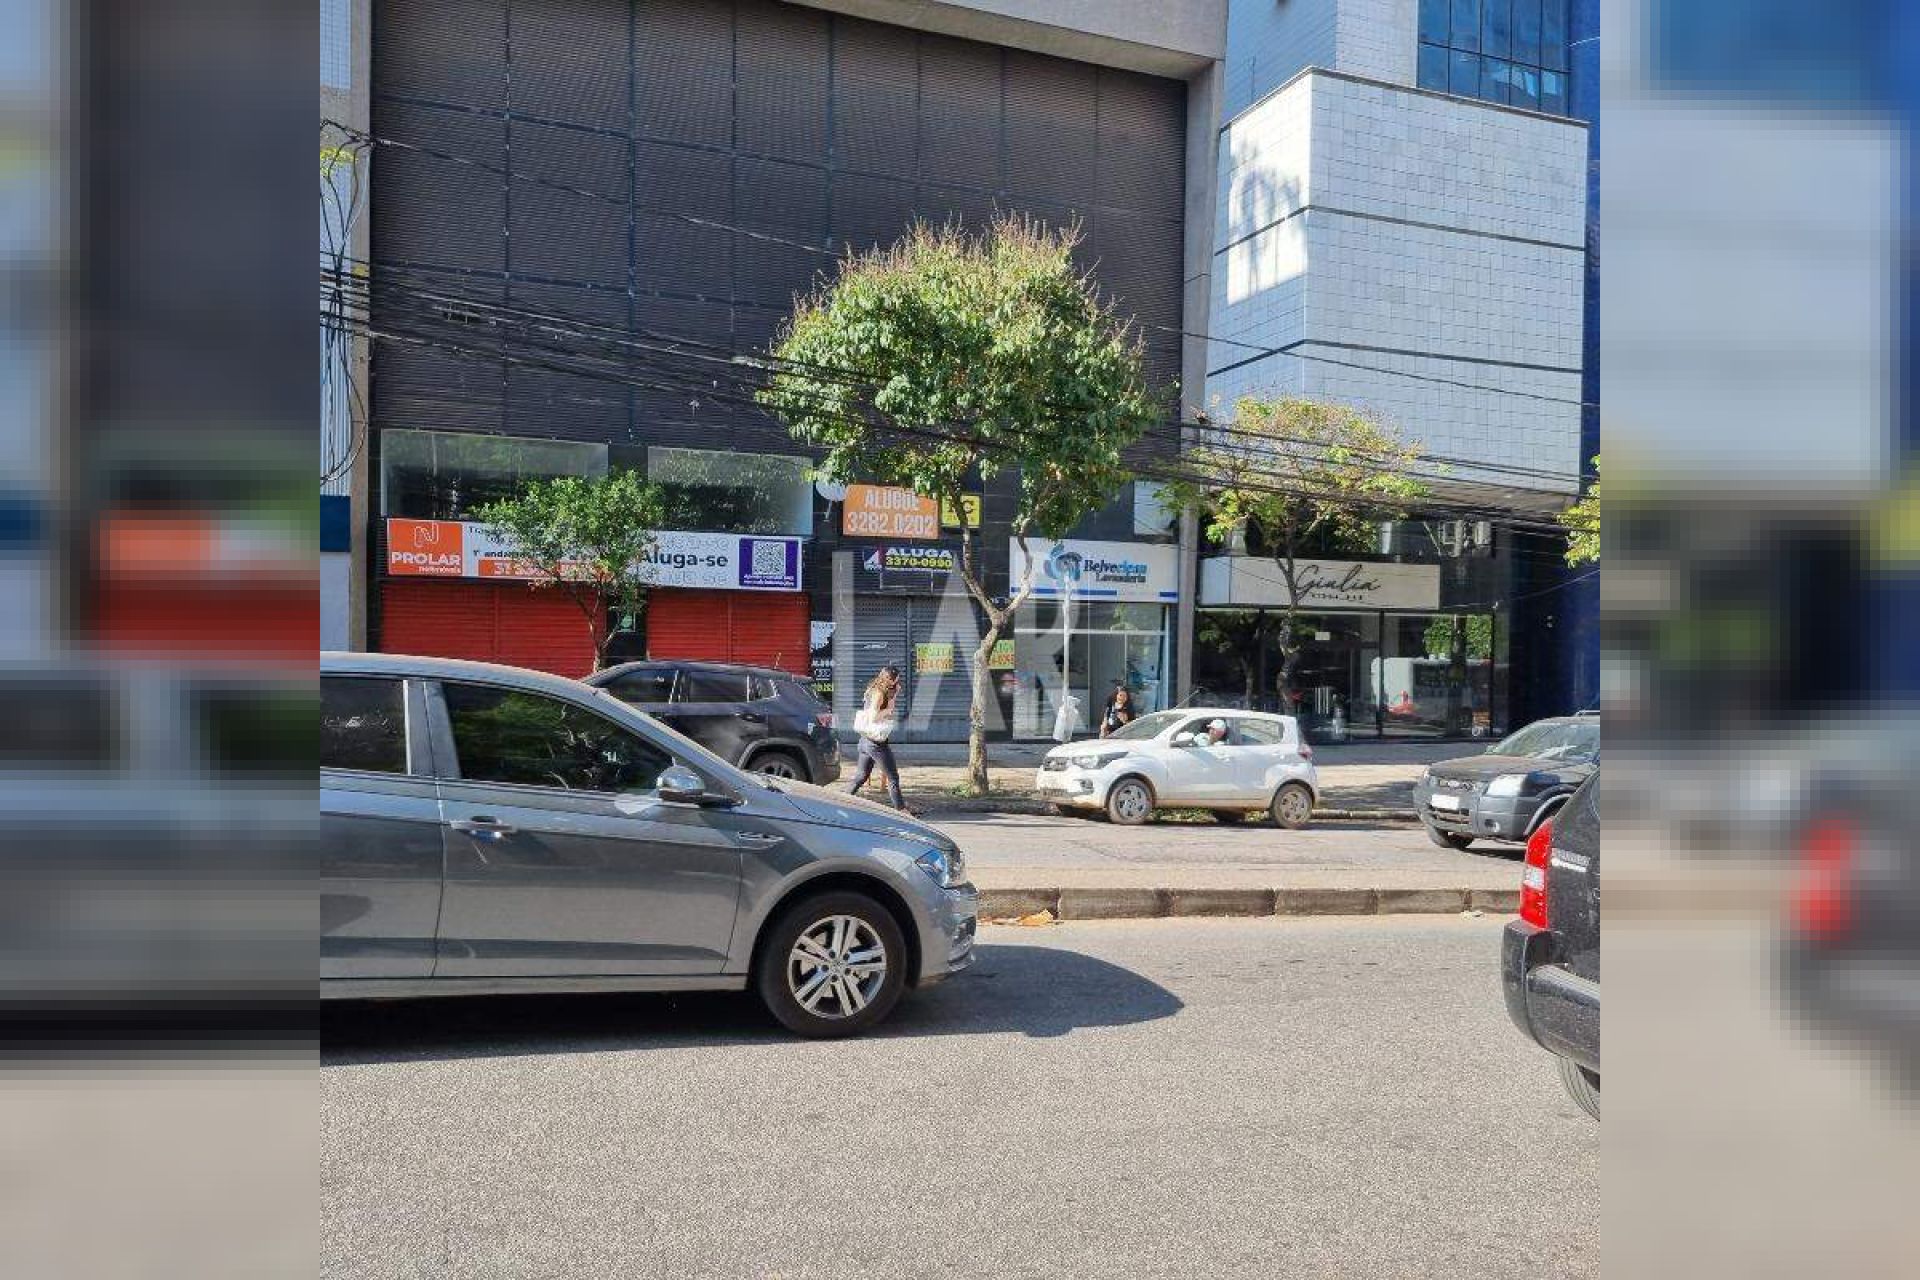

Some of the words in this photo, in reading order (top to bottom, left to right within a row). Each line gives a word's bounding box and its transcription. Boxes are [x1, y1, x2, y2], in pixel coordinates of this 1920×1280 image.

[847, 511, 935, 535] 3282.0202
[391, 552, 461, 566] PROLAR
[884, 547, 953, 559] ALUGA
[1296, 564, 1382, 600] Giulia
